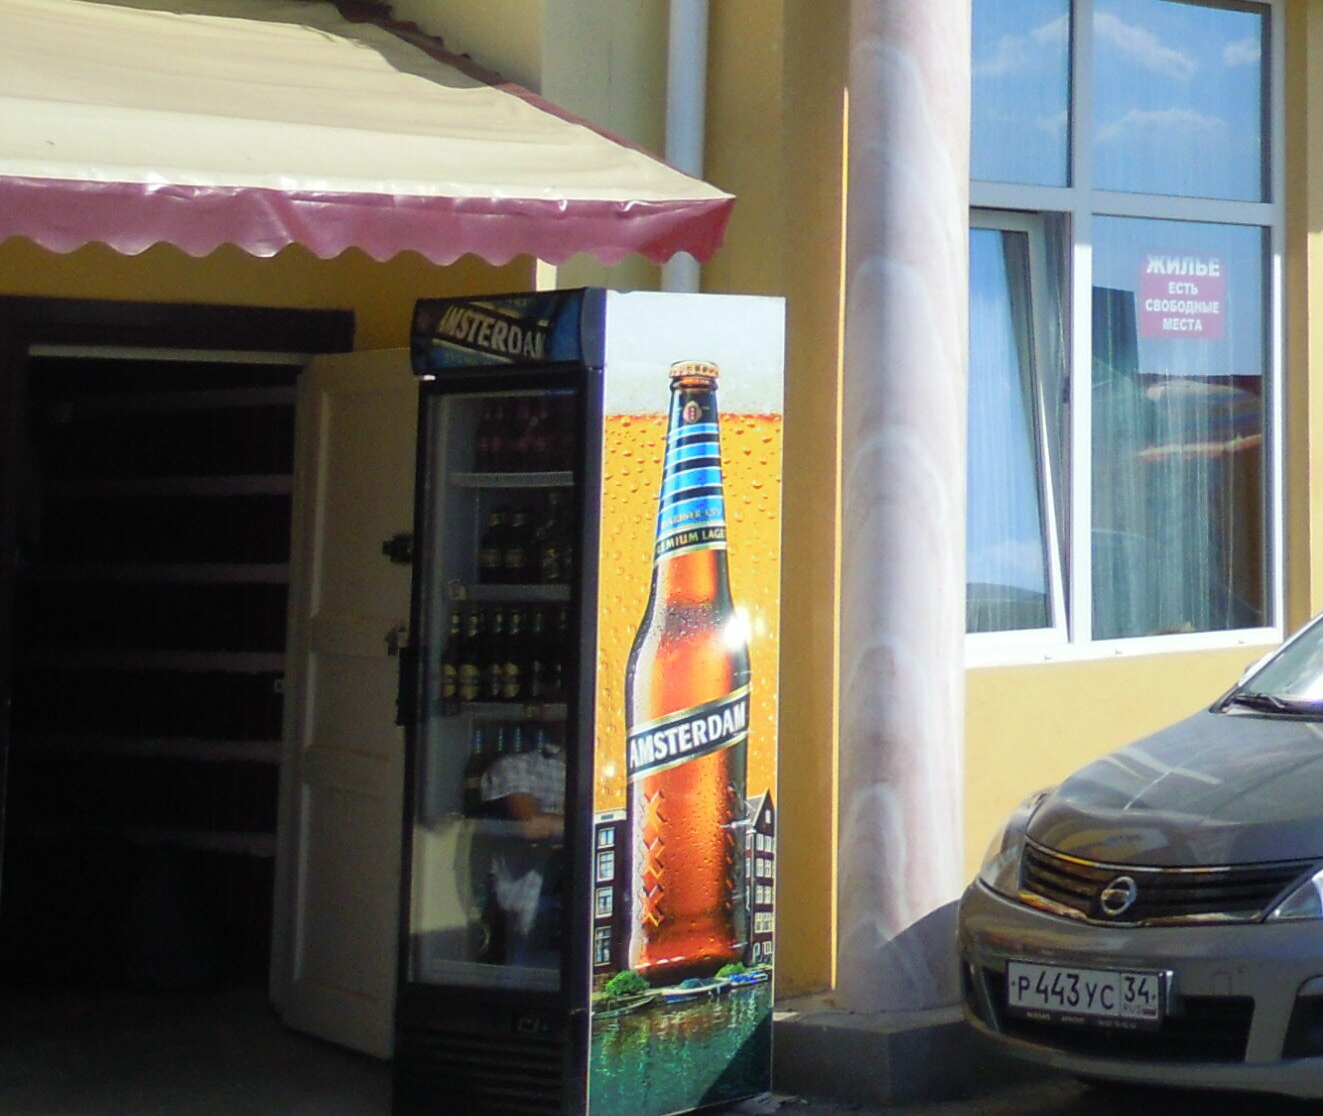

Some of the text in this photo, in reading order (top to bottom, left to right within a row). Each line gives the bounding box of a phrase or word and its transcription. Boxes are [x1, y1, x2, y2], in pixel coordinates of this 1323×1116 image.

[1145, 254, 1221, 277] ЖИЛЬЕ
[1168, 281, 1200, 296] ЕСТЬ
[1145, 298, 1221, 315] СВОБОДНЫЕ
[1162, 317, 1203, 332] МЕСТА
[629, 701, 747, 769] AMSTERDAM
